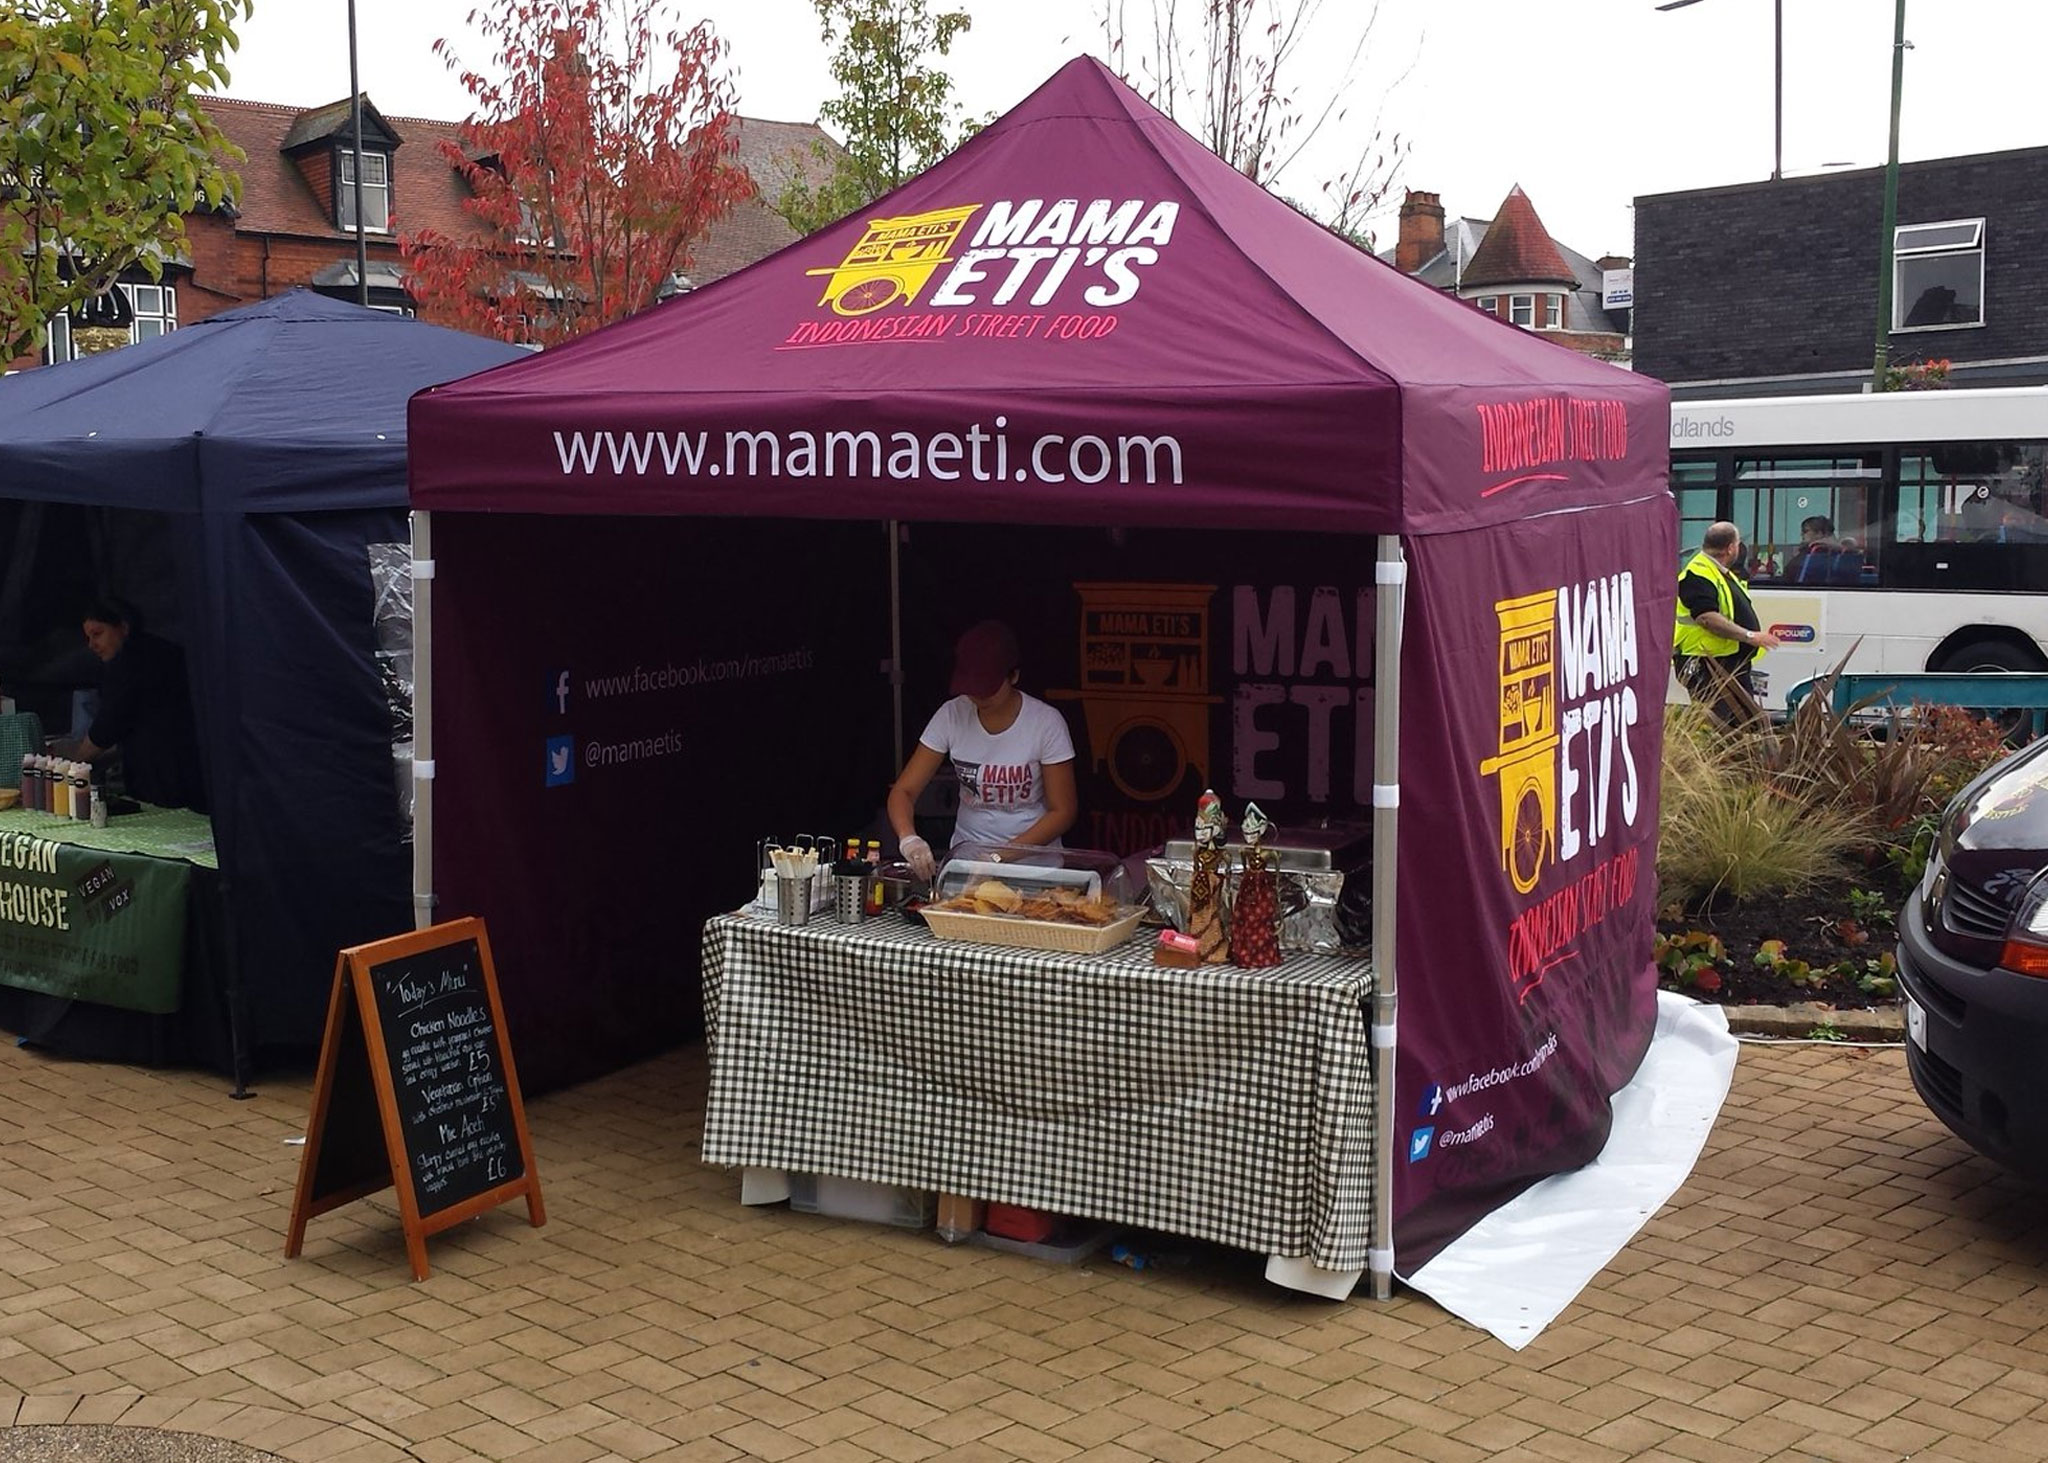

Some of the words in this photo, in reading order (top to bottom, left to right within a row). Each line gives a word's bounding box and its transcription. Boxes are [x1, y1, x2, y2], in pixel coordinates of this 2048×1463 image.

[878, 226, 917, 241] MAMA
[970, 199, 1180, 247] MAMA
[929, 246, 1160, 308] ETI'S
[786, 313, 957, 344] INDONESIAN
[957, 313, 1045, 338] STREET
[1047, 315, 1119, 339] FOOD
[1476, 398, 1565, 473] INDONESIAN
[1567, 397, 1600, 462] STREET
[554, 416, 1184, 486] www.mamaeti.com
[1100, 612, 1151, 635] MAMA
[585, 646, 815, 699] www.facebook.com/mamaetis
[585, 729, 683, 768] @mamaetis
[982, 763, 1033, 784] MAMA
[982, 781, 1033, 804] ETI'S
[78, 866, 115, 897] VEGAN
[109, 889, 130, 910] VOX
[410, 1021, 445, 1038] Chicken
[447, 1006, 486, 1029] Noodles
[469, 1049, 490, 1071] £5
[488, 1157, 507, 1181] £6
